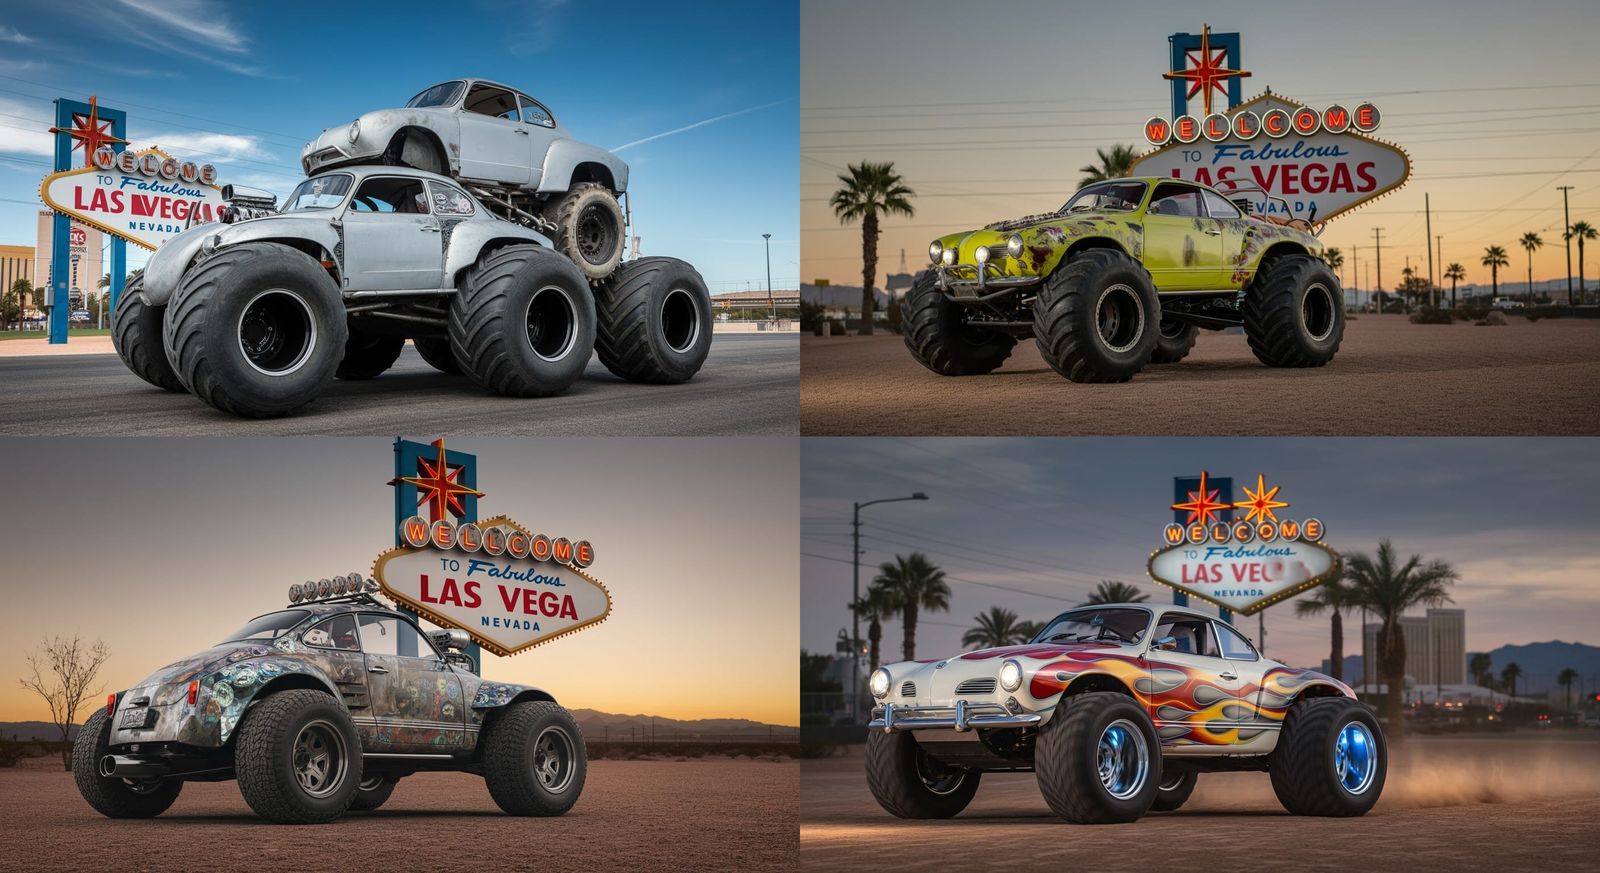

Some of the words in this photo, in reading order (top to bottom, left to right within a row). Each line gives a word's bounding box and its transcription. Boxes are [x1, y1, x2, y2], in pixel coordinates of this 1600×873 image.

[1148, 107, 1373, 140] WELLCOME
[1182, 151, 1202, 162] TO
[1212, 140, 1349, 165] Fabulous
[97, 149, 213, 182] WELOME
[1251, 161, 1377, 195] VEGAS
[97, 175, 113, 186] TO
[120, 176, 206, 198] Fabulous
[74, 185, 125, 215] LAS
[129, 221, 180, 233] NEVADA
[406, 522, 591, 562] WELLCOME
[1167, 521, 1319, 541] WELCOME
[1184, 550, 1198, 560] TO
[1204, 545, 1296, 562] Fabulous
[440, 558, 460, 571] TO
[467, 558, 566, 587] Fabulous
[1181, 563, 1223, 584] LAS
[420, 574, 482, 609] LAS
[497, 584, 579, 621] VEGA
[1214, 589, 1264, 597] NEVANDA
[481, 616, 541, 632] NEVADA
